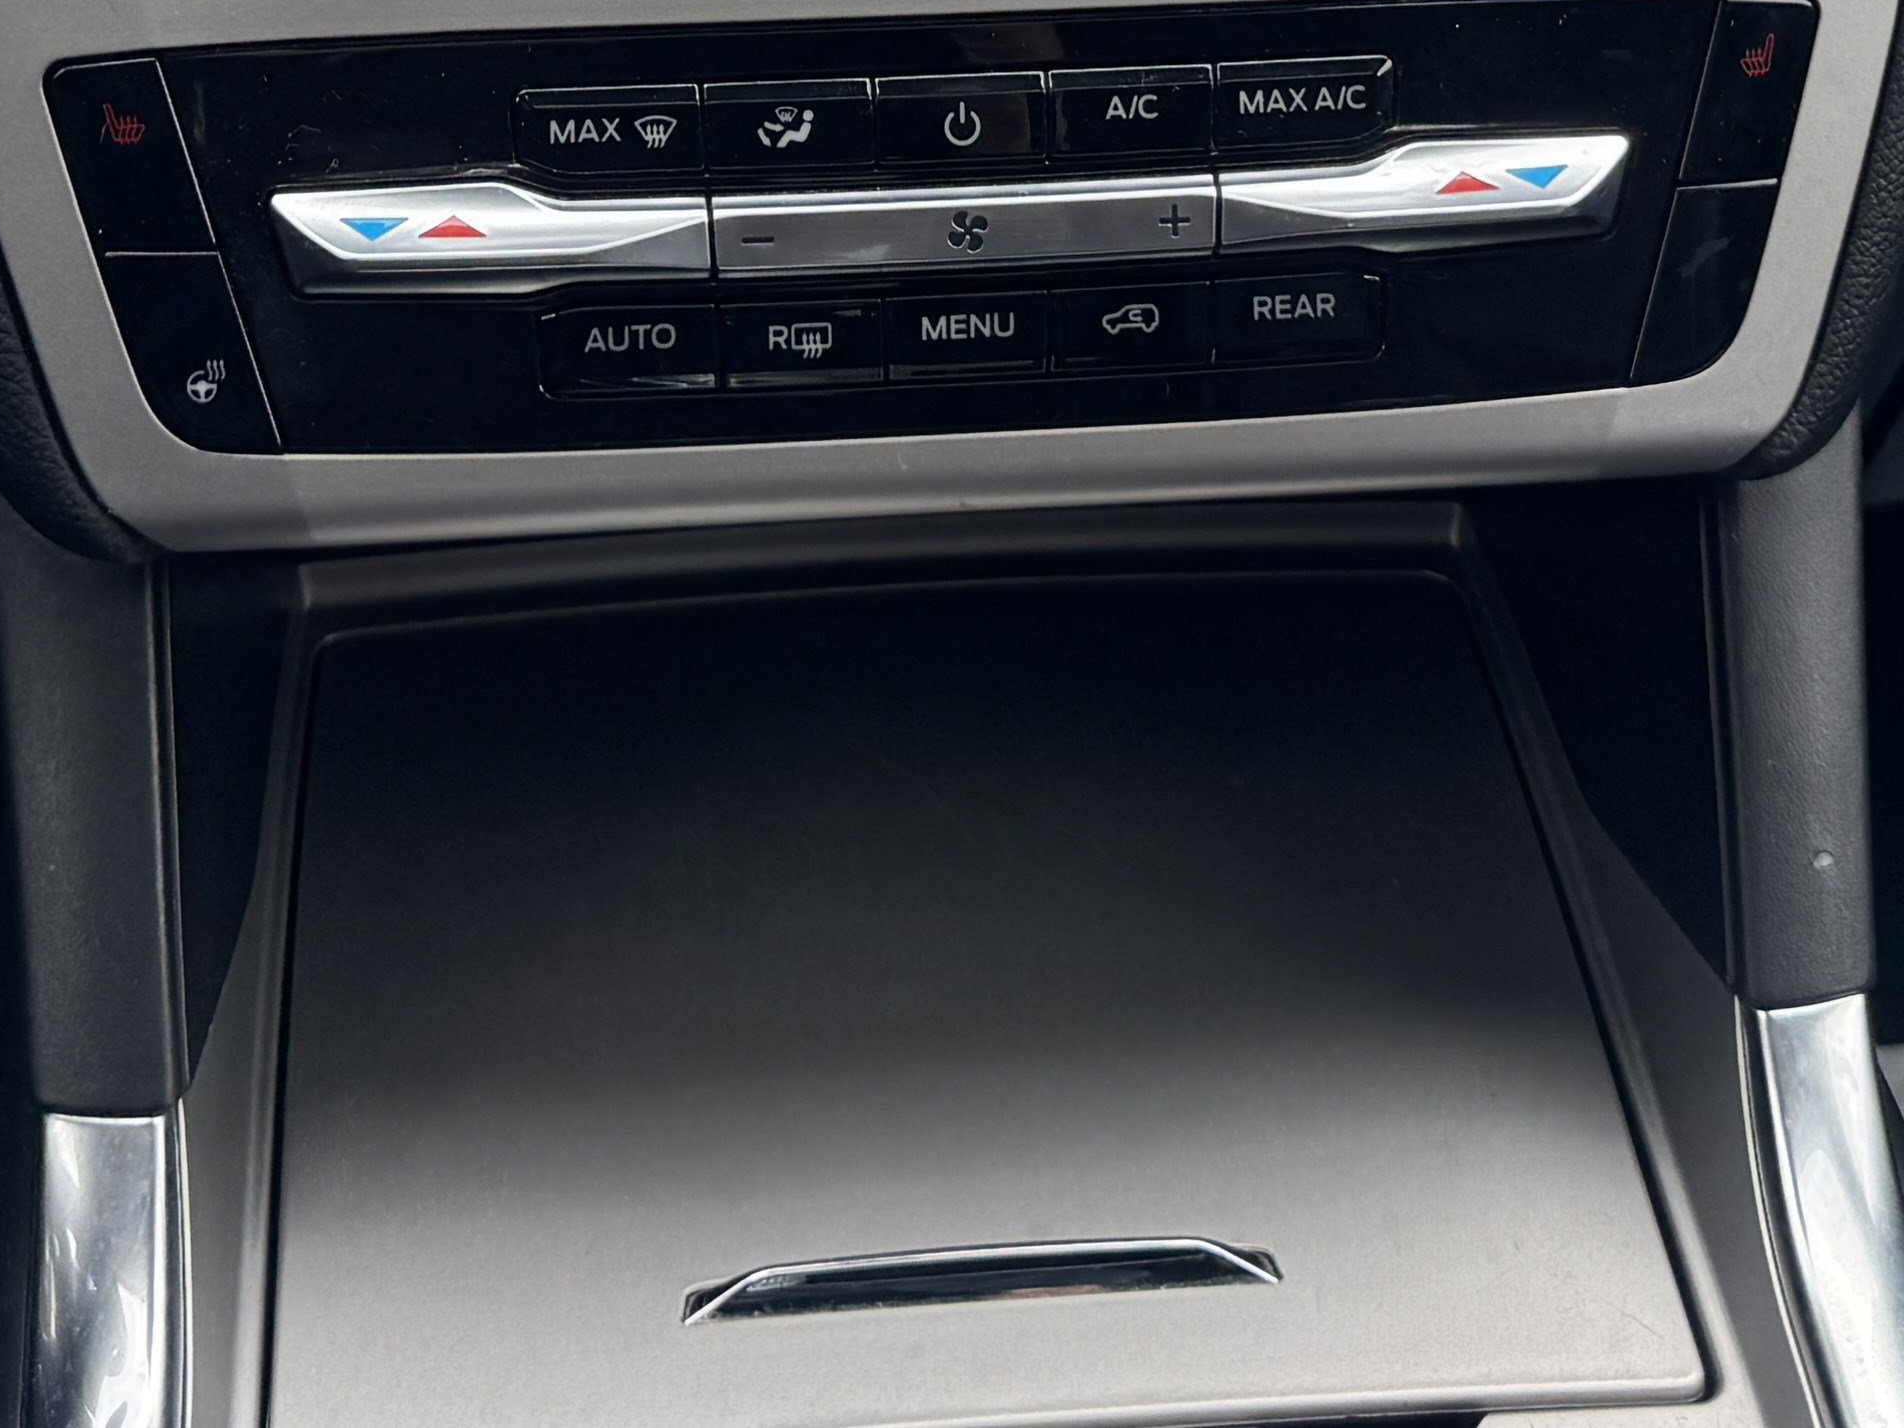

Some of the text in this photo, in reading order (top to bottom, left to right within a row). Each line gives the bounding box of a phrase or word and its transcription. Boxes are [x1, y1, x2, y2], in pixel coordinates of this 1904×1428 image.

[1105, 93, 1159, 120] A/C
[1239, 84, 1367, 115] MAX A/C
[549, 117, 621, 145] MAX
[1252, 292, 1336, 321] REAR
[584, 322, 677, 353] AUTO
[921, 312, 1015, 341] MENU
